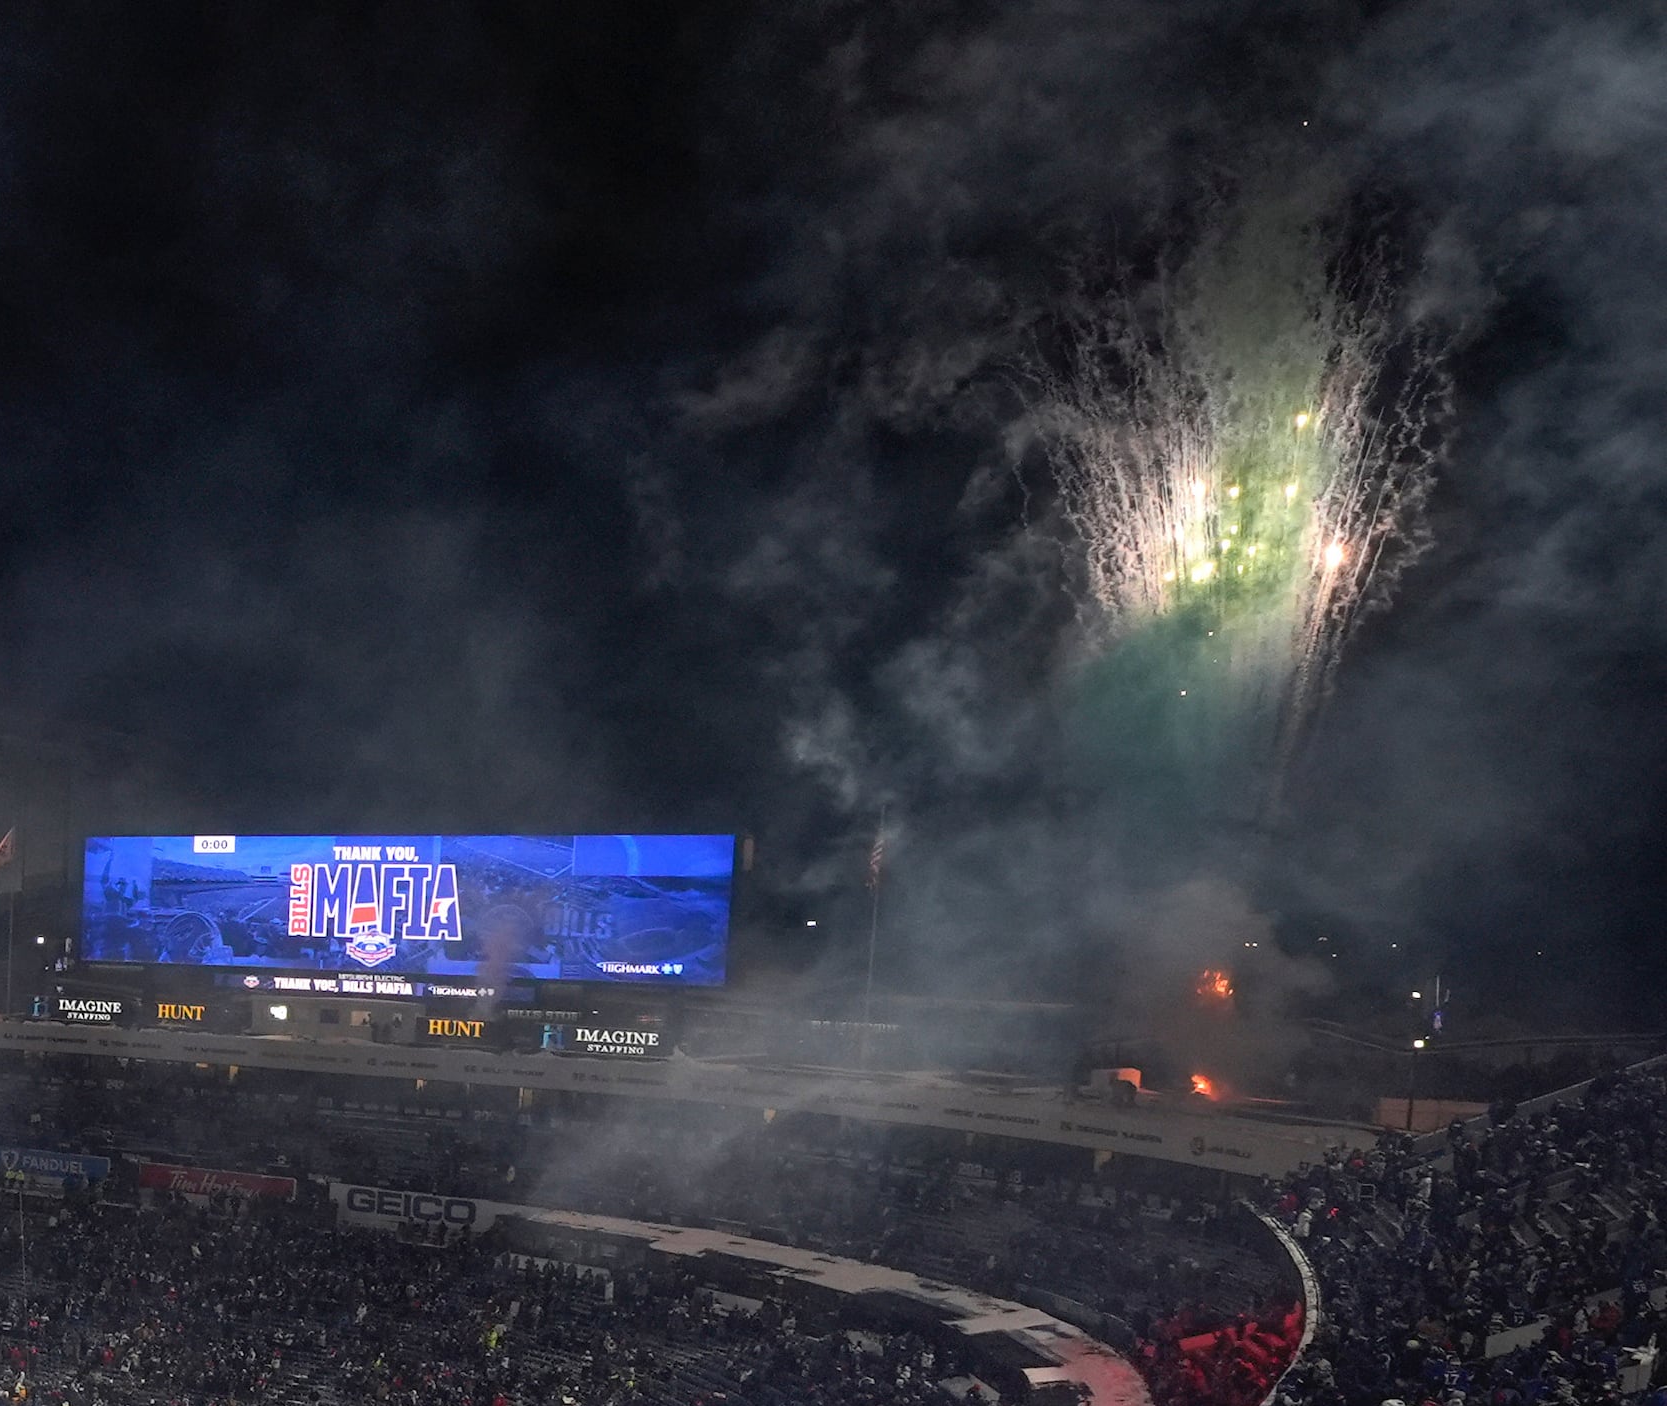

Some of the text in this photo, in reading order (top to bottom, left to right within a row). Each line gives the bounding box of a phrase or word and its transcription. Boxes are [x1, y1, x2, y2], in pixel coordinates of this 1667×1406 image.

[201, 839, 229, 850] 0:00
[333, 846, 419, 863] THANK YOU,
[288, 863, 313, 936] BILLS
[312, 863, 463, 941] MAFIA
[599, 962, 660, 974] HIGHMARK
[273, 977, 312, 991] THANK
[342, 980, 374, 994] BILLS
[375, 982, 413, 996] MAFIA
[430, 986, 478, 997] HIGHMARK
[58, 999, 123, 1014] IMAGINE
[157, 1003, 205, 1021] HUNT
[66, 1011, 112, 1022] STAFFING
[427, 1018, 485, 1039] HUNT
[575, 1028, 659, 1046] IMAGINE
[586, 1043, 645, 1055] STAFFING
[22, 1153, 85, 1176] FANDUEL
[170, 1170, 195, 1192] Tim
[346, 1187, 477, 1225] GEICO
